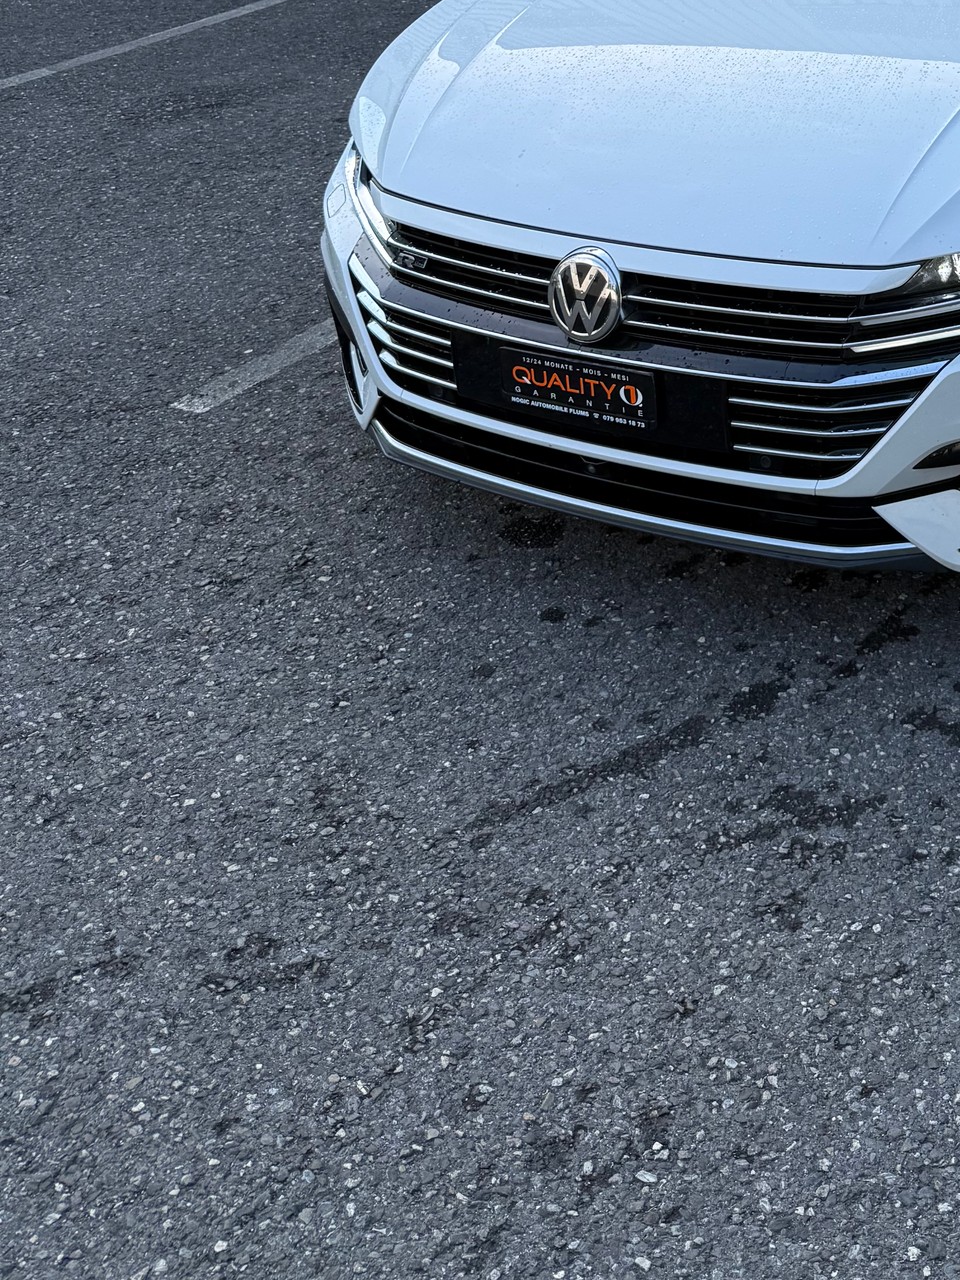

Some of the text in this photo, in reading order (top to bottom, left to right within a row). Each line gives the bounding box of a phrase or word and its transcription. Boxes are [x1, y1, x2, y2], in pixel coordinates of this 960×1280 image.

[512, 365, 616, 400] QUALITY
[522, 356, 542, 366] 12/24
[544, 360, 574, 372] MONATE
[582, 367, 602, 377] MOIS
[610, 373, 630, 382] MESI
[514, 385, 644, 417] GARANTIE
[530, 400, 568, 413] AUTOMOBILE
